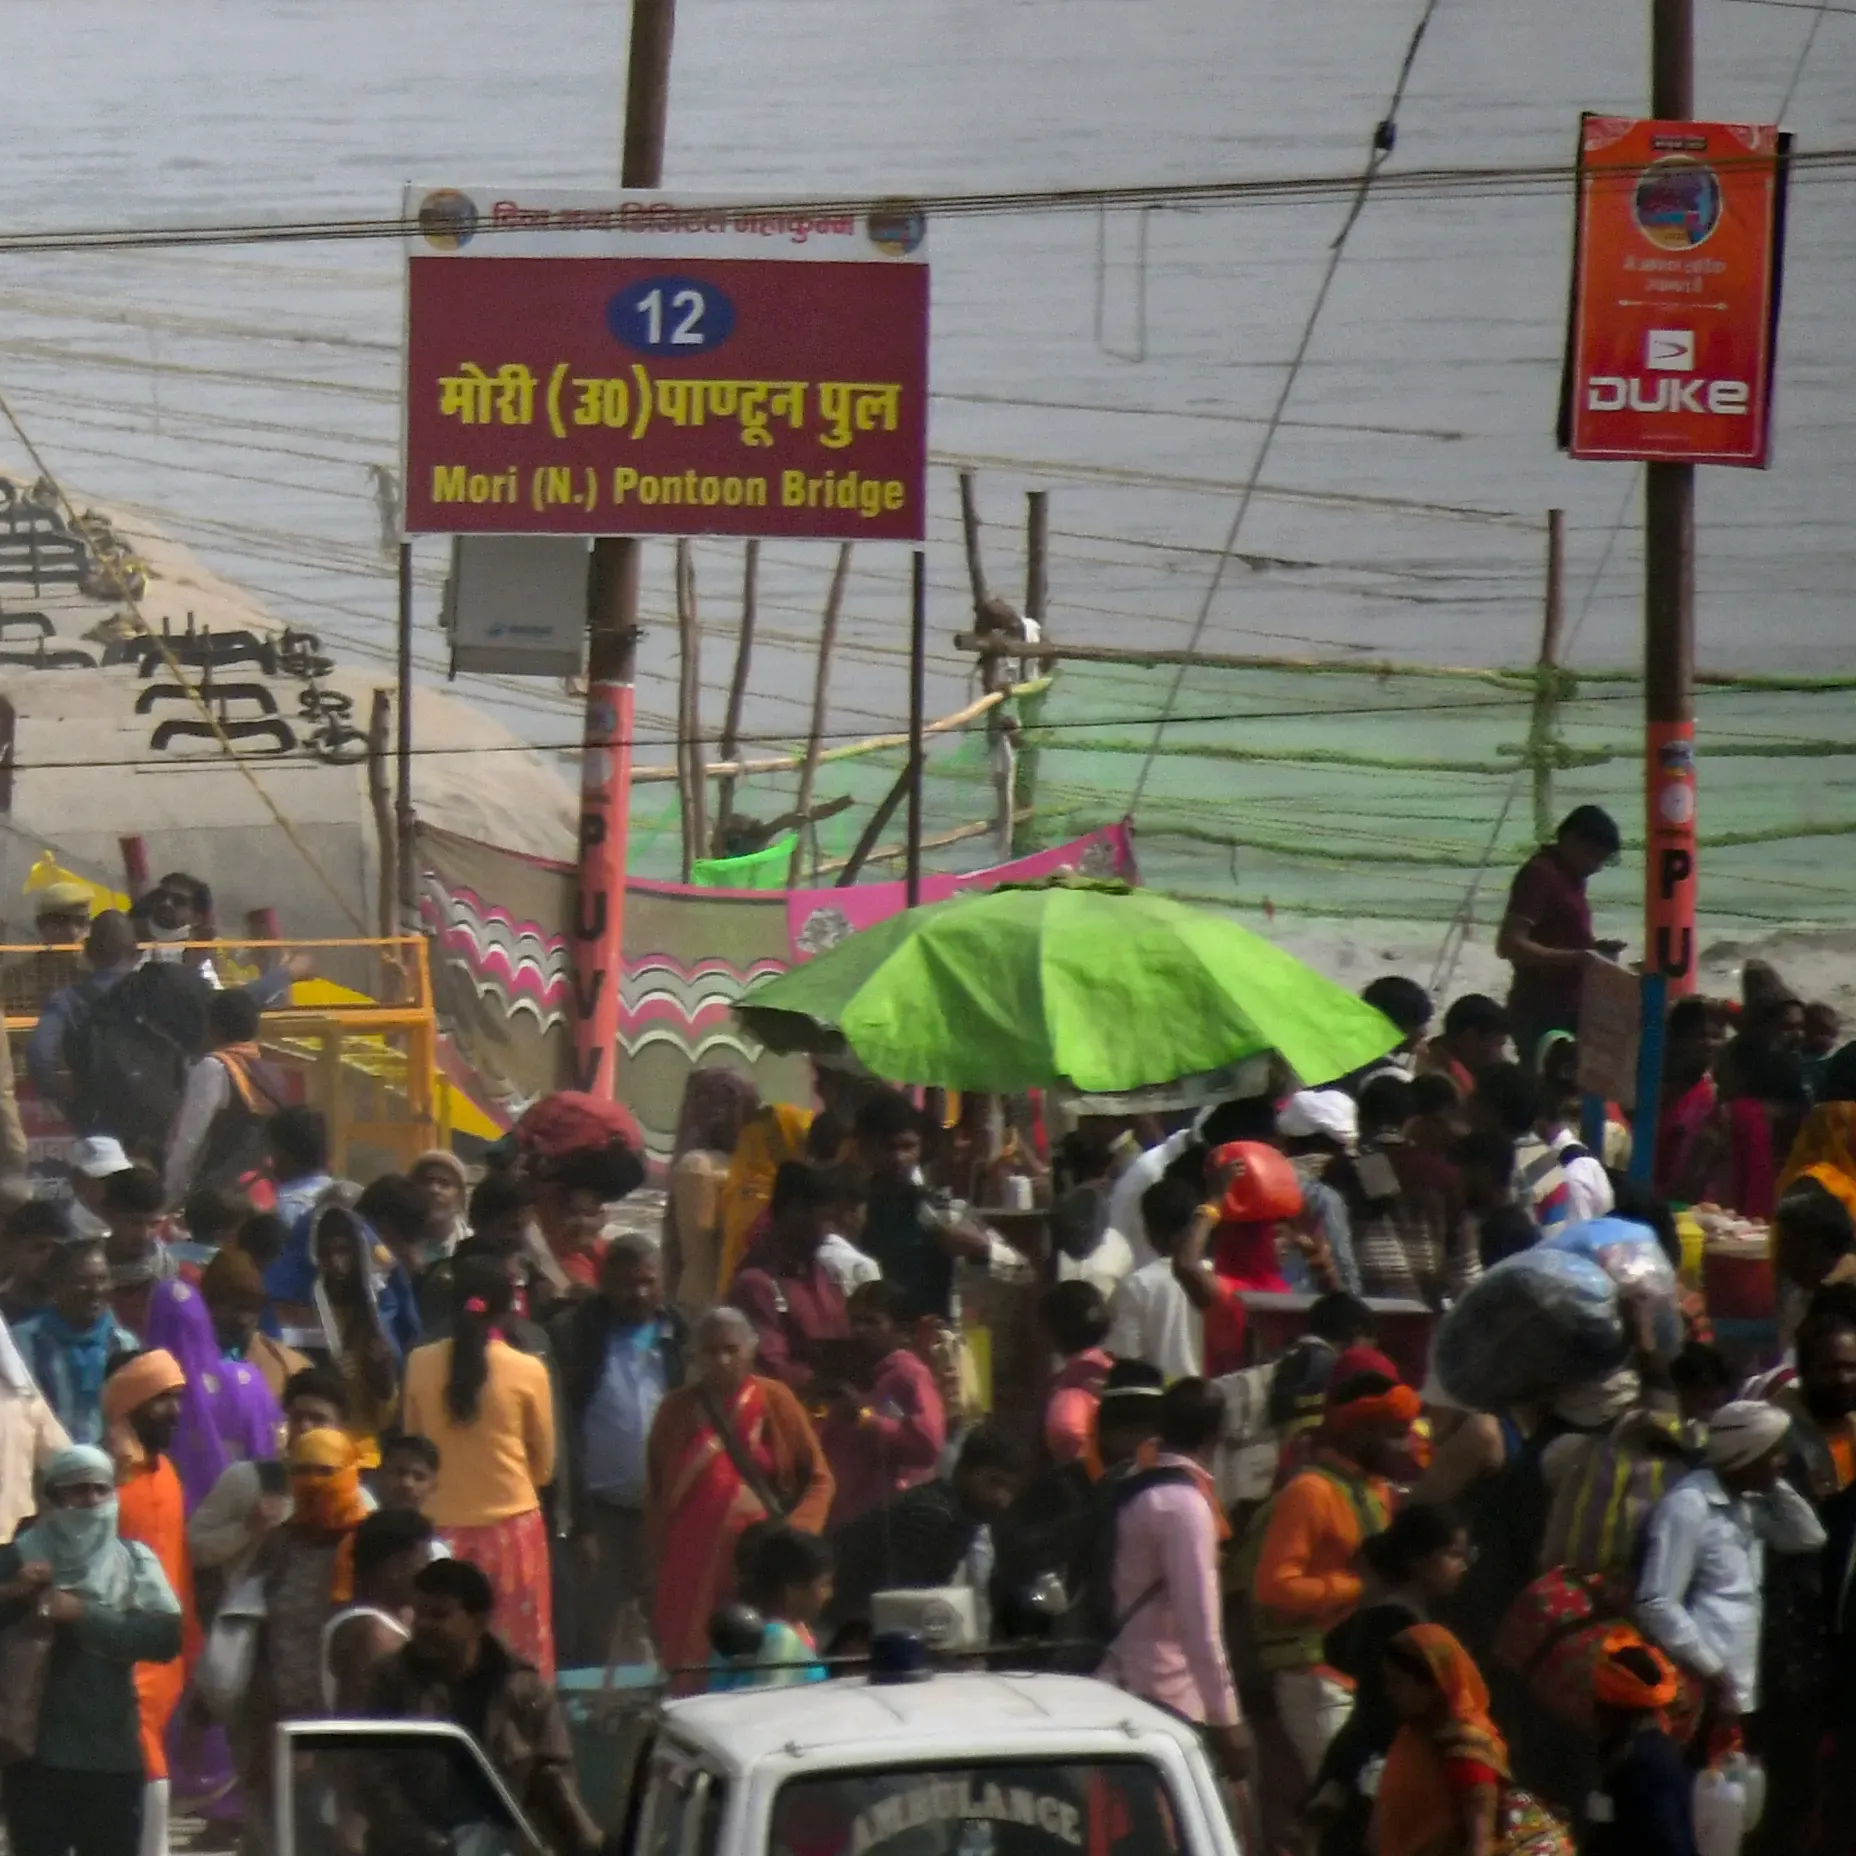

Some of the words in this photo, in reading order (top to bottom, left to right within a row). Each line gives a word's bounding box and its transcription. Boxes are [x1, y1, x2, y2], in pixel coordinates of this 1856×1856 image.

[637, 289, 706, 345] 12
[437, 361, 538, 426] मोरी
[654, 380, 809, 447] पाण्टून
[819, 382, 901, 449] पुल
[432, 465, 518, 504] Mori
[533, 466, 598, 512] (N.)
[613, 467, 767, 507] Pontoon
[782, 470, 905, 517] Bridge
[851, 1779, 1083, 1856] AMBULANCE
